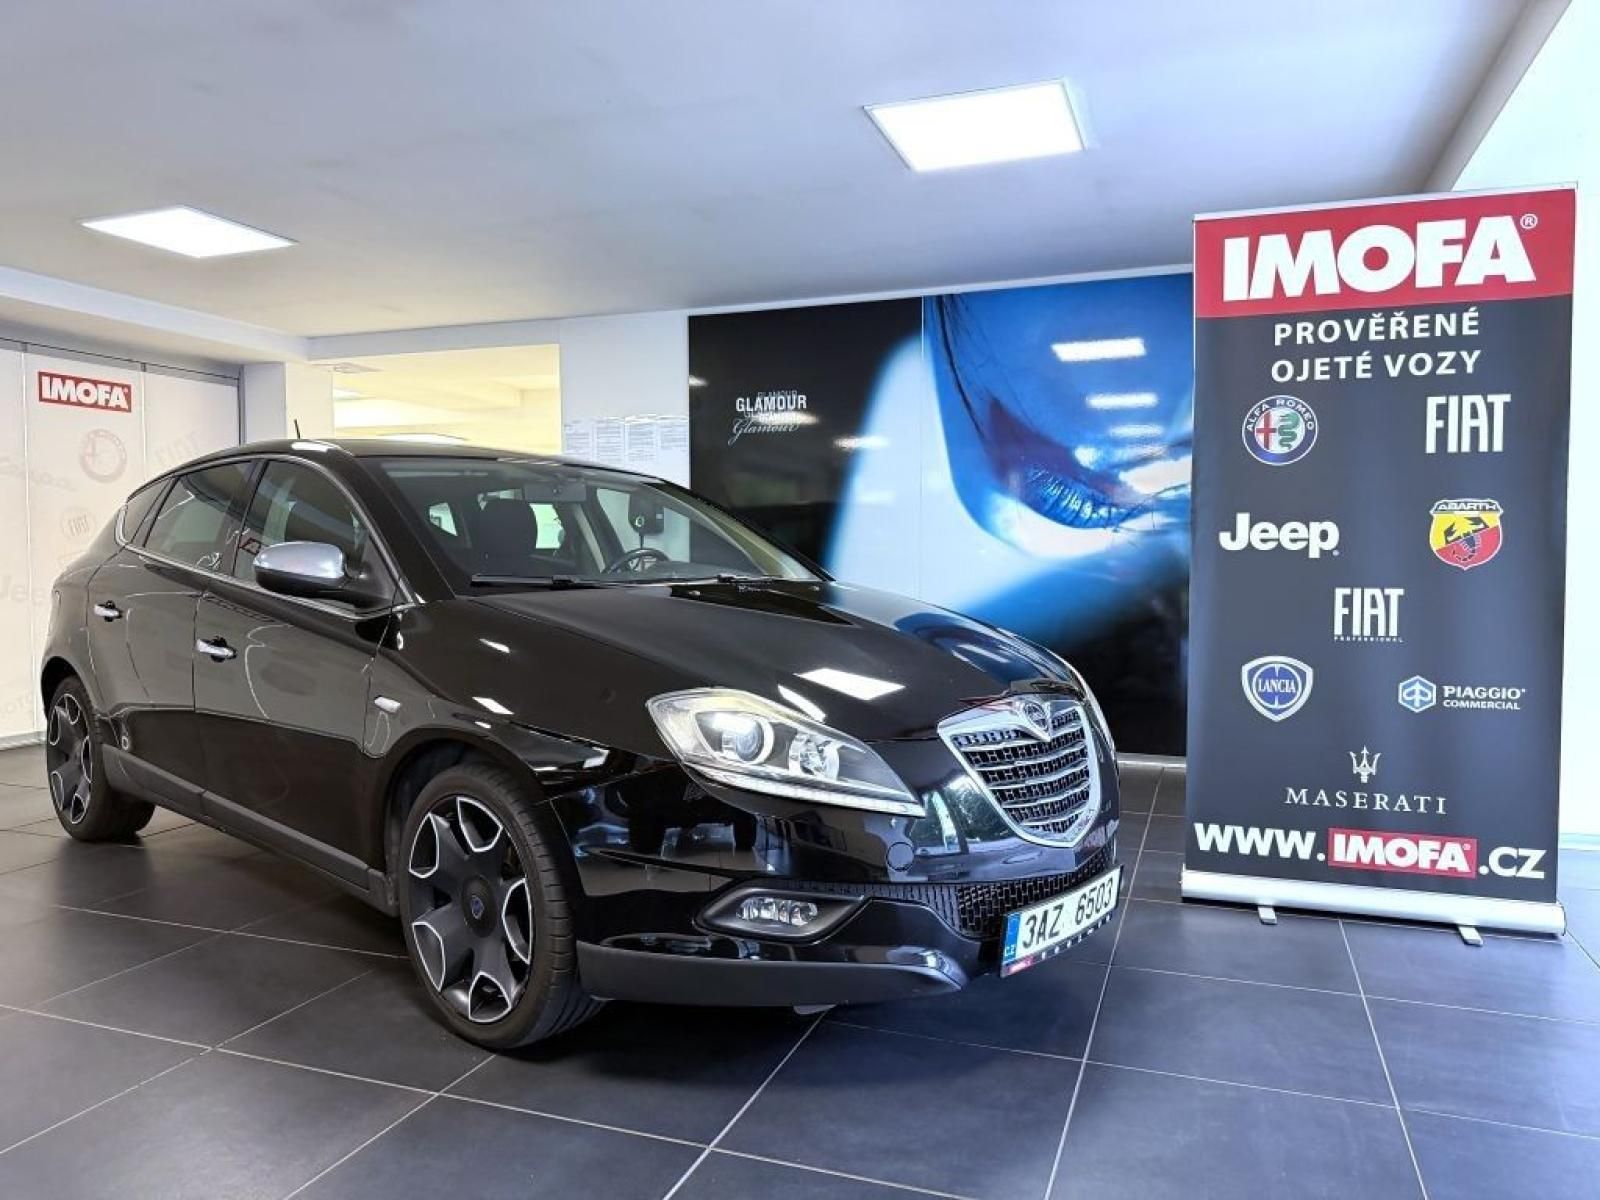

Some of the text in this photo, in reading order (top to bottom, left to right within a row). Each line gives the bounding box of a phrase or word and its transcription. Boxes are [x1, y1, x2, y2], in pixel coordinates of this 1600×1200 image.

[1274, 306, 1480, 346] PROVĚŘENÉ
[1271, 349, 1482, 383] OJETÉ VOZY
[735, 394, 808, 412] GLAMOUR
[1246, 399, 1315, 432] ALFA ROMEO
[1425, 394, 1512, 454] FIAT
[1438, 502, 1496, 511] ABARTH
[1218, 512, 1340, 559] Jeep
[1333, 587, 1405, 636] FIAT
[1257, 678, 1297, 694] LANCIA
[1442, 699, 1521, 711] COMMERCIAL
[1283, 786, 1447, 815] MASERATI
[1022, 902, 1065, 949] 3AZ
[1075, 877, 1114, 926] 6503
